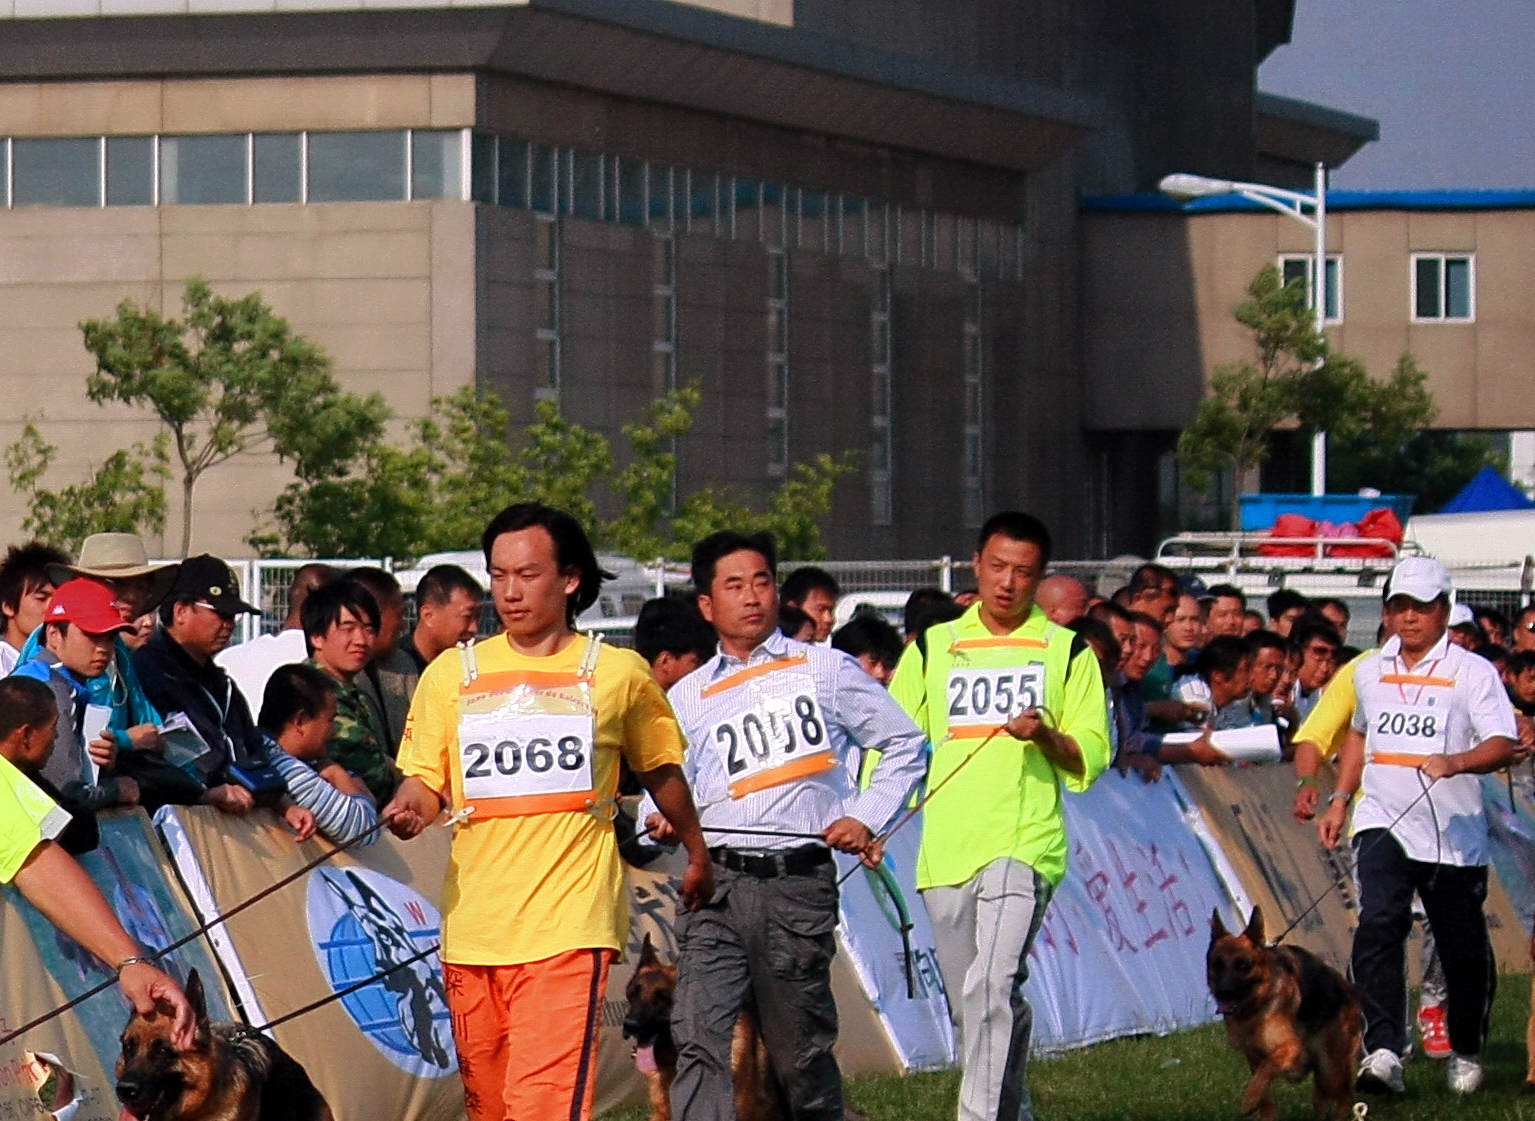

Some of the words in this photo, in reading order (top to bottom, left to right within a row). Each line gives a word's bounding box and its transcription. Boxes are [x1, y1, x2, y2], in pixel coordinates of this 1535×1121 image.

[949, 673, 1037, 716] 2055
[1377, 711, 1436, 737] 2038
[464, 735, 585, 779] 2068
